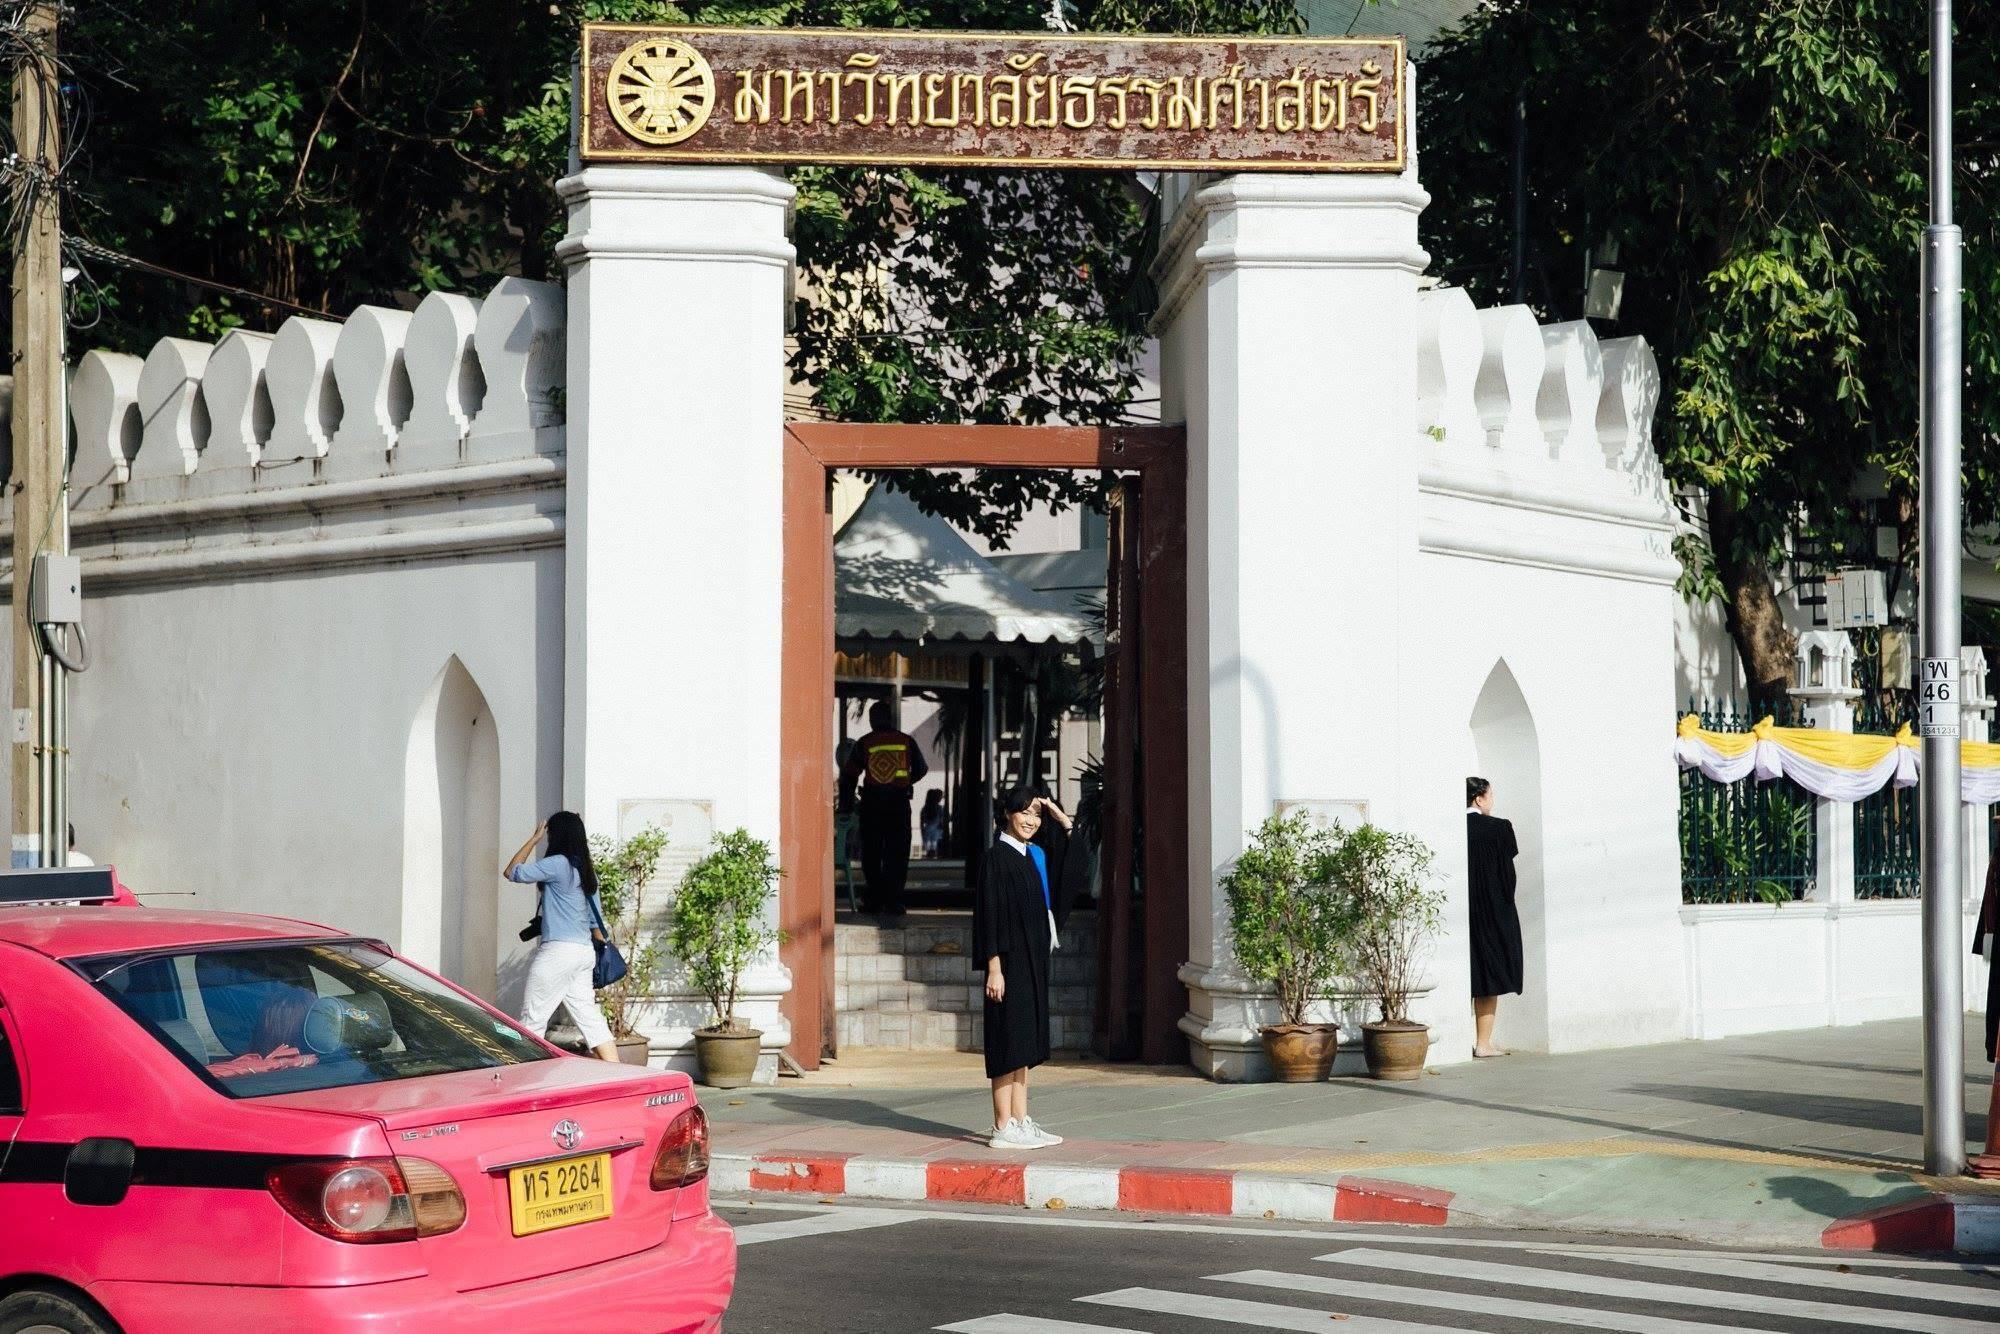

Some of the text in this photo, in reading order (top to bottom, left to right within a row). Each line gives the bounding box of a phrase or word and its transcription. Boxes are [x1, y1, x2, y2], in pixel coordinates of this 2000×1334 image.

[733, 52, 1383, 132] มหาวิทยาลัยธรรมศาสตร์
[1924, 683, 1950, 701] 46
[1925, 705, 1933, 723] 1
[523, 1160, 600, 1202] ทร 2264
